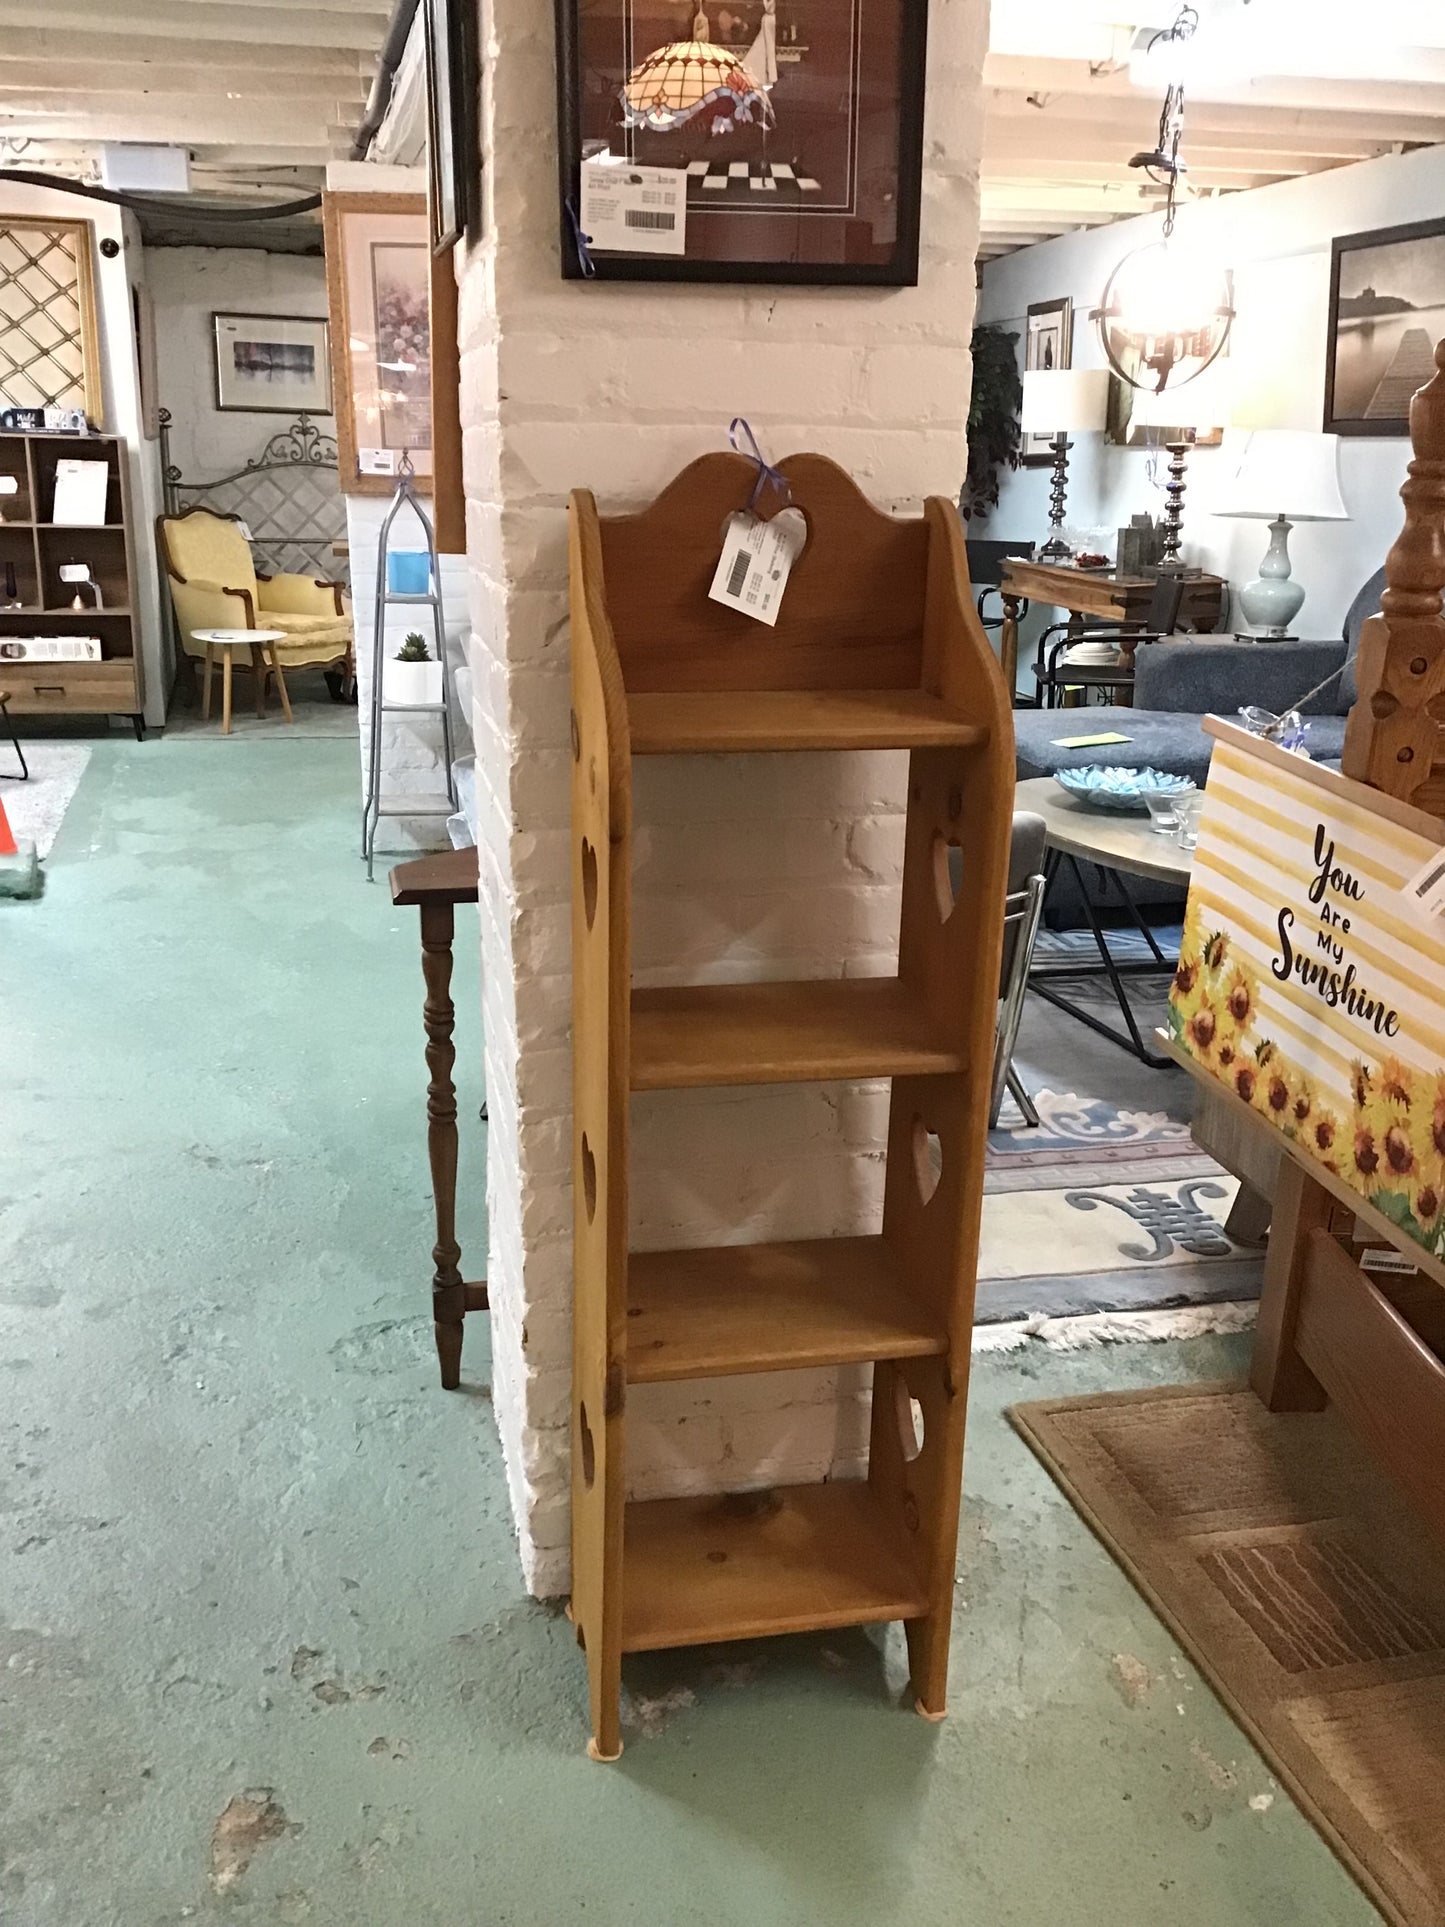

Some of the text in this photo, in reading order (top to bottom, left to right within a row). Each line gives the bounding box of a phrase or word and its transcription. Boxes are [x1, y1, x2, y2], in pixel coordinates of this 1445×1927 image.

[1309, 824, 1365, 903] You
[1320, 902, 1350, 934] Are
[1271, 907, 1400, 1037] Sunshine
[1317, 930, 1343, 964] My
